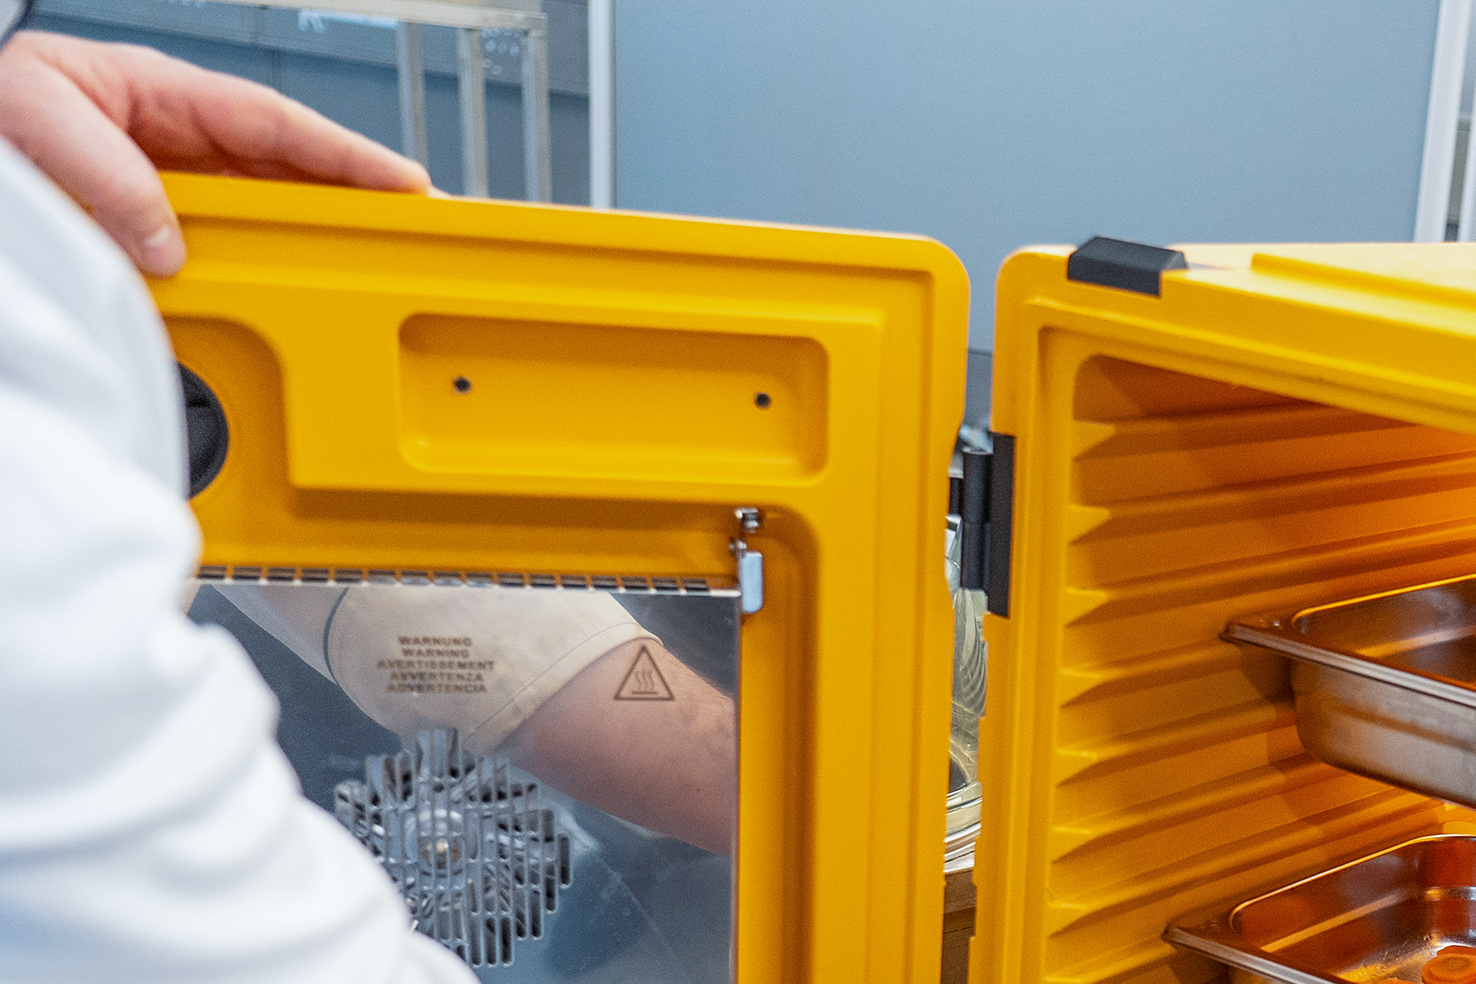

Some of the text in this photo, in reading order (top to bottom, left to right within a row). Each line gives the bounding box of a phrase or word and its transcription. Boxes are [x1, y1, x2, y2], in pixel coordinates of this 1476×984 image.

[399, 636, 472, 646] WARNUNG
[402, 648, 470, 658] WARNING
[377, 659, 495, 670] AVERTISSEMENT
[390, 671, 485, 682] AVVERTENZA
[387, 683, 488, 693] ADVERTENCIA
